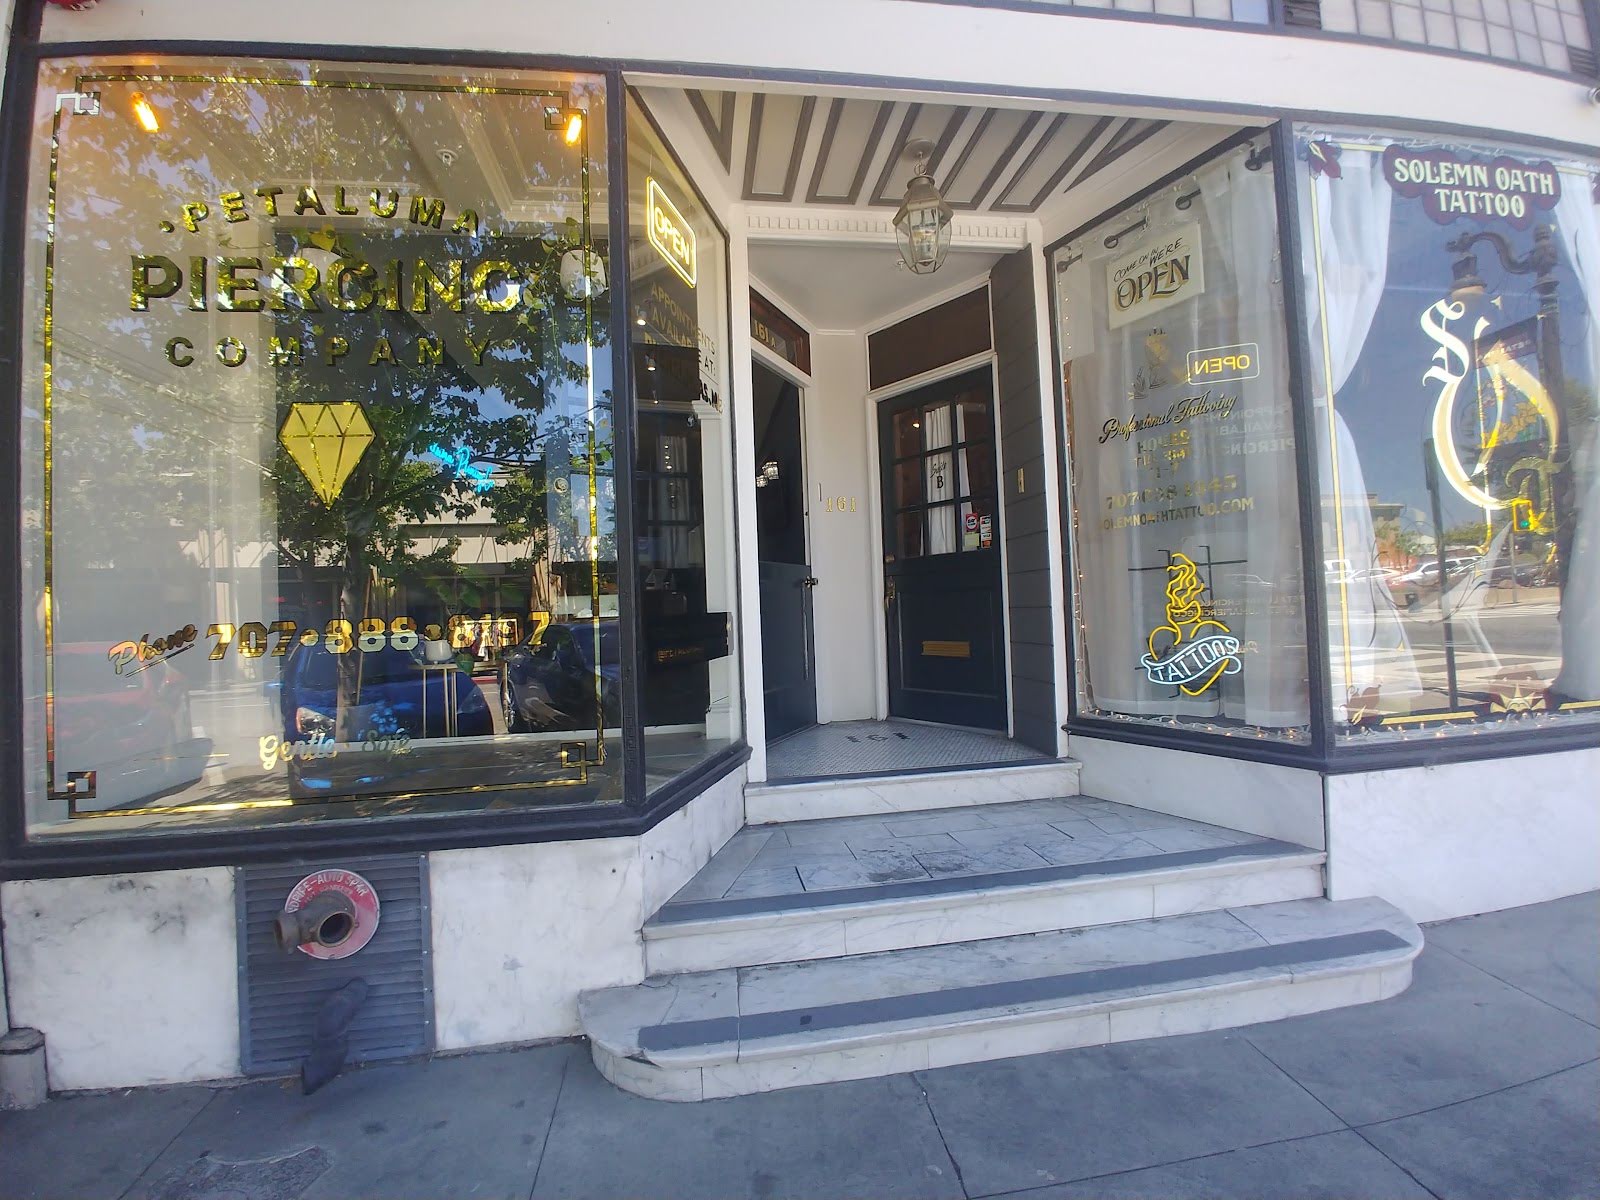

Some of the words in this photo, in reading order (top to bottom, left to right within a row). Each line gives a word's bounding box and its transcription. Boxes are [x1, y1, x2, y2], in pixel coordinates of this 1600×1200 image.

[1394, 158, 1489, 189] SOLEMN
[1494, 166, 1555, 196] OATH
[180, 185, 480, 235] PETALUMA
[1434, 187, 1526, 219] TATTOO
[653, 205, 691, 265] OPEN
[1148, 237, 1183, 266] WE'RE
[129, 254, 524, 314] PIERCING
[1113, 263, 1138, 283] COME
[1138, 254, 1150, 266] ON
[1115, 254, 1191, 311] OPEN
[165, 335, 495, 368] COMPANY
[1098, 403, 1176, 444] Professional
[1172, 389, 1238, 424] Tattooing
[936, 476, 944, 489] B
[825, 496, 857, 513] 161
[108, 624, 199, 675] Phone
[1152, 639, 1237, 682] TATTOOS
[259, 732, 338, 771] Gentle
